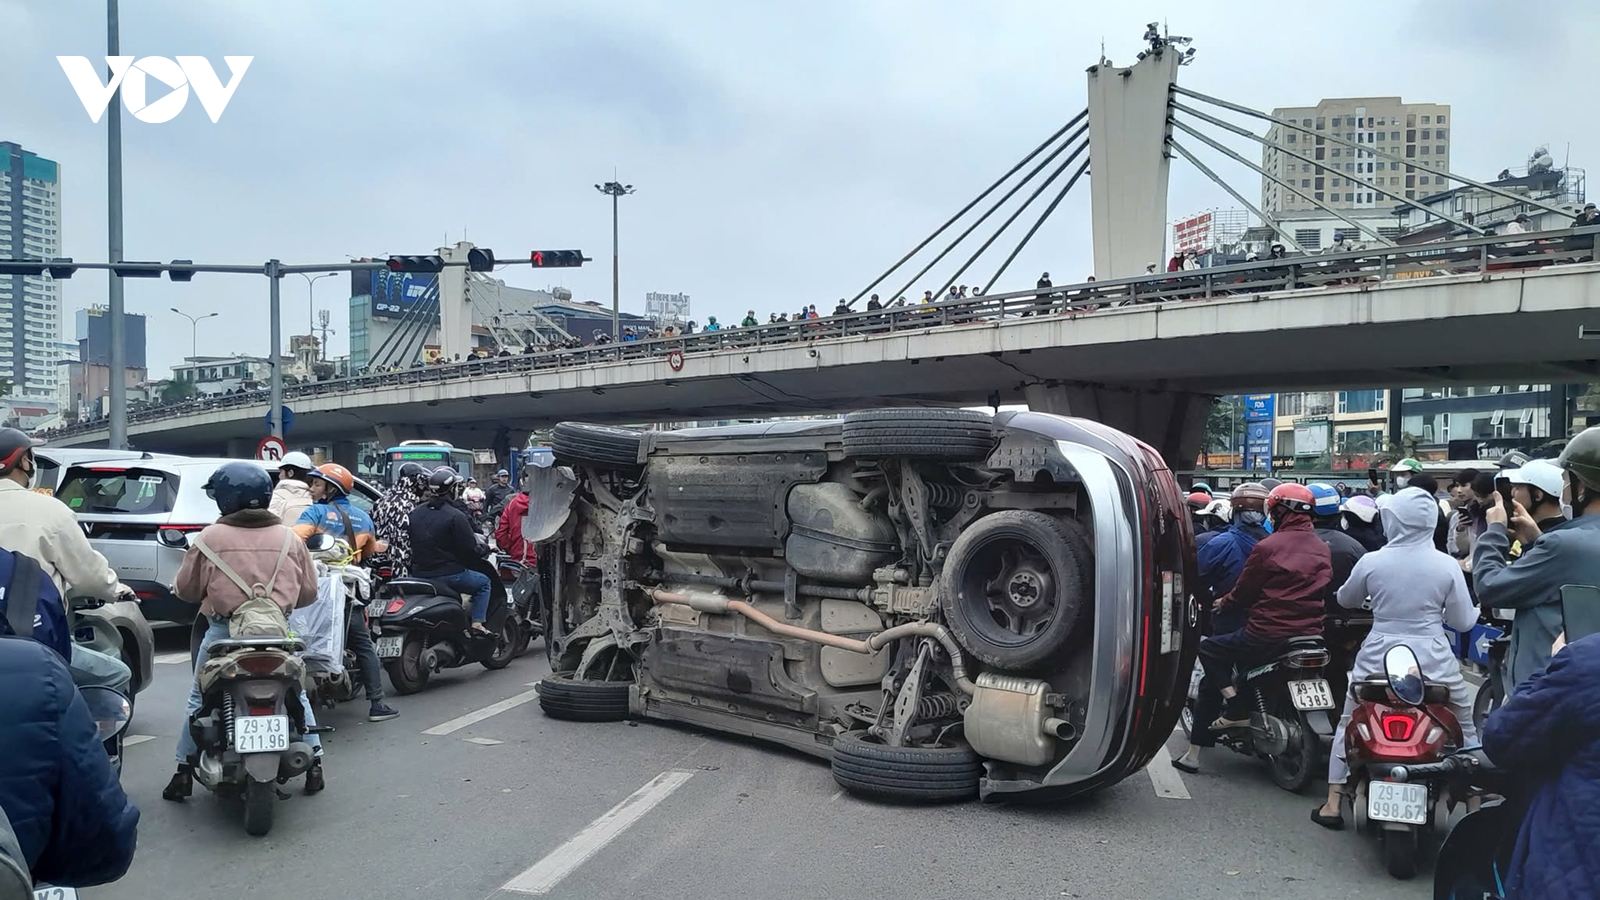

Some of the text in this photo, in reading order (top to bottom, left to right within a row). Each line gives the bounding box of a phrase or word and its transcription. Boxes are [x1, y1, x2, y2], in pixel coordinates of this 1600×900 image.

[1301, 694, 1329, 707] 4385
[244, 718, 281, 734] 29-X3
[239, 733, 286, 750] 211.96
[1378, 784, 1418, 803] 29-AD
[1373, 801, 1423, 820] 998.67
